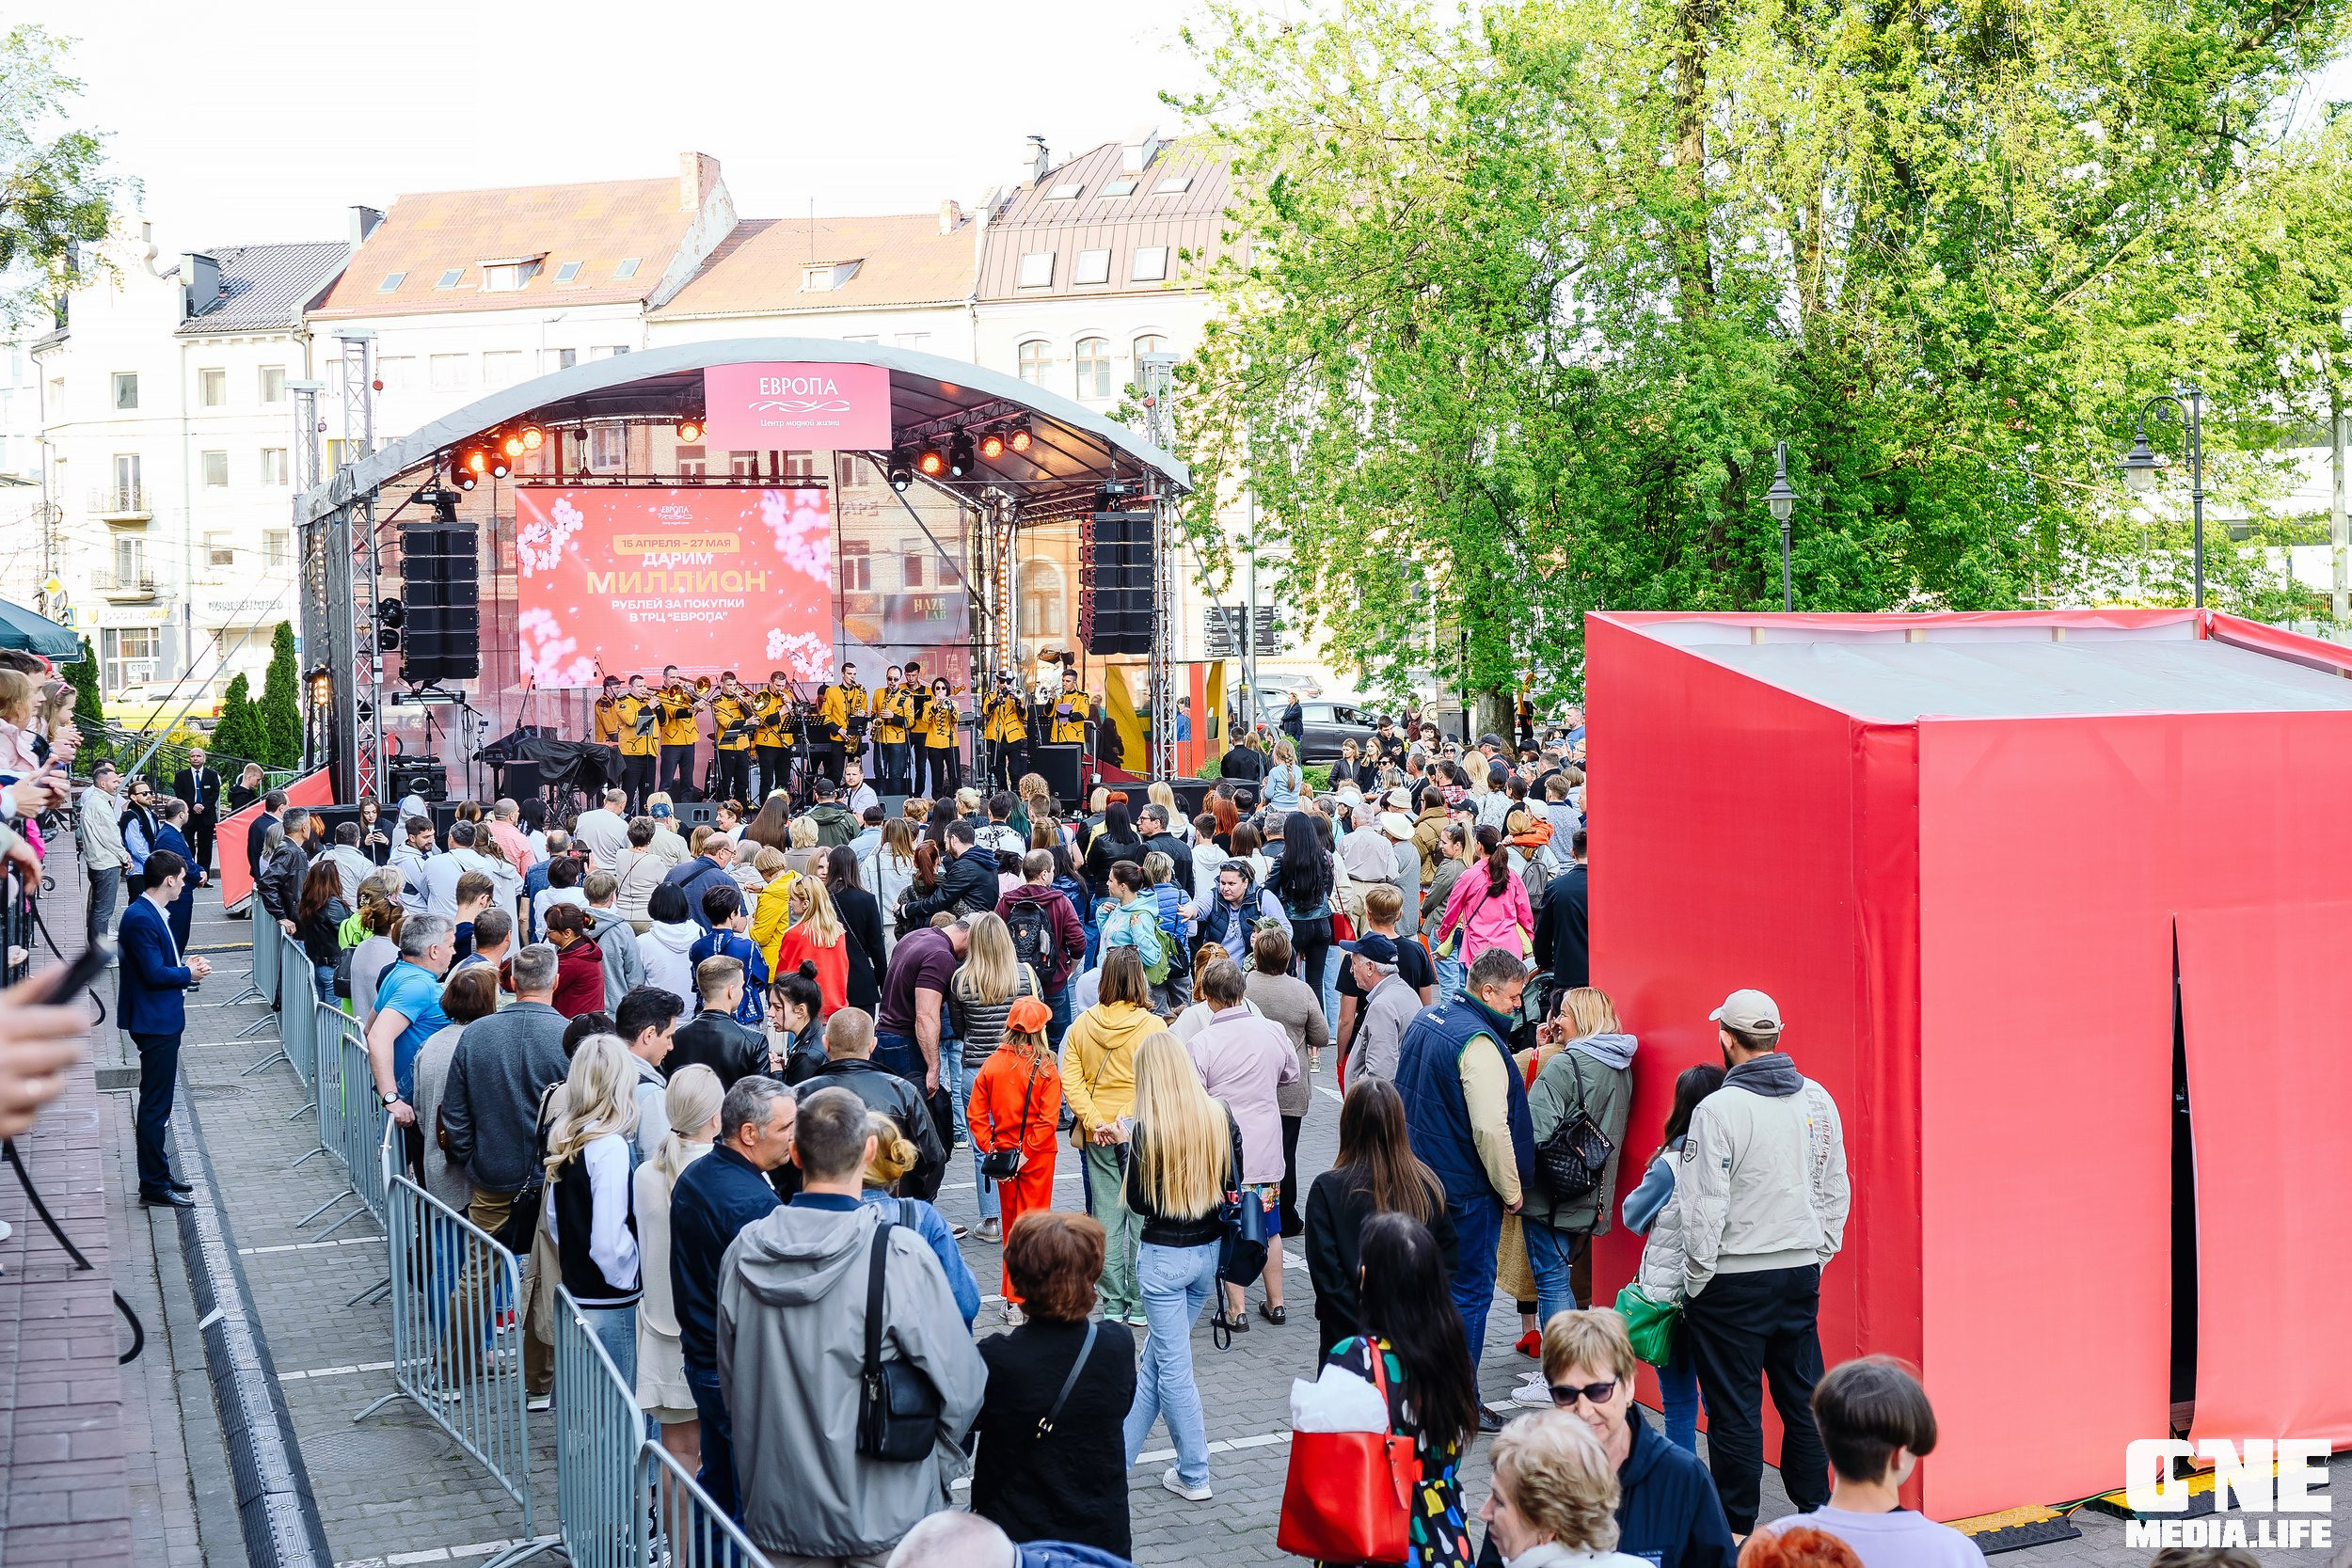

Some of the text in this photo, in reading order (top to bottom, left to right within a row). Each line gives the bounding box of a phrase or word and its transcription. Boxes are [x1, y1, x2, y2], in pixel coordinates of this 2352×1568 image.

[759, 377, 839, 395] ЕВРОПА
[760, 420, 784, 428] Центр
[787, 420, 814, 428] модной
[661, 505, 690, 514] ЕВРОПА
[636, 539, 681, 547] АПРЕЛЯ
[691, 539, 704, 547] 27
[706, 539, 731, 547] МАЯ
[643, 552, 713, 567] ДАРИМ
[587, 570, 766, 594] МИЛЛИОН
[612, 597, 744, 610] РУБЛЕЙ ЗА ПОКУПКИ
[914, 598, 946, 612] HAZE
[629, 613, 638, 623] В
[642, 612, 666, 624] ТРЦ
[925, 610, 946, 621] LAB
